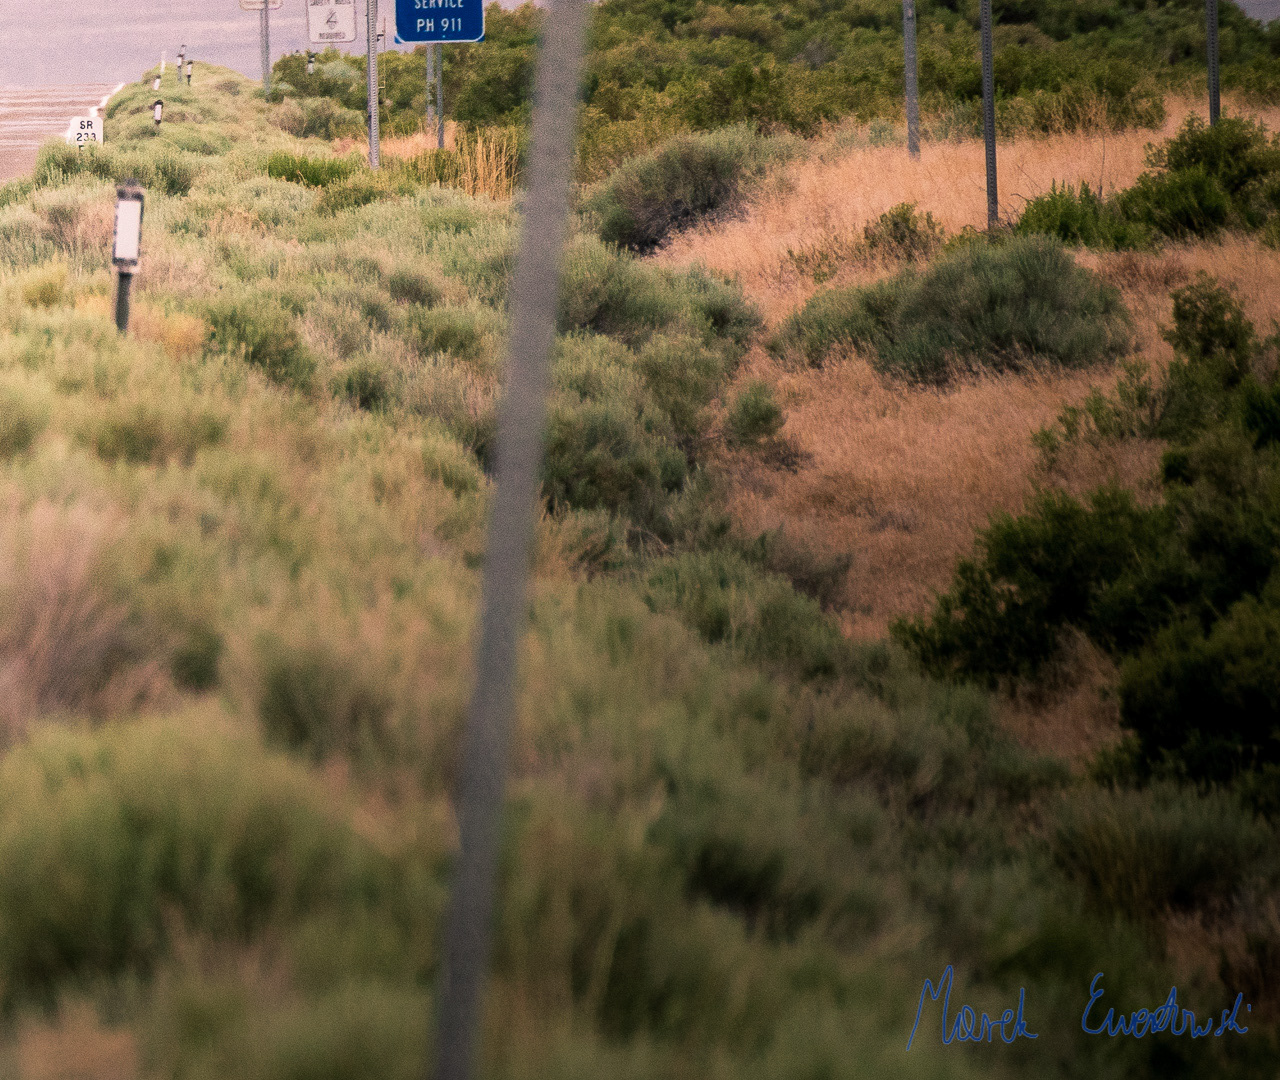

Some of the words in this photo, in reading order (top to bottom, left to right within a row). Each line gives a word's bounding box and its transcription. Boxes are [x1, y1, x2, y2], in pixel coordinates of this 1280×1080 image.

[417, 18, 435, 33] PH
[442, 17, 463, 32] 911
[80, 120, 93, 130] SR
